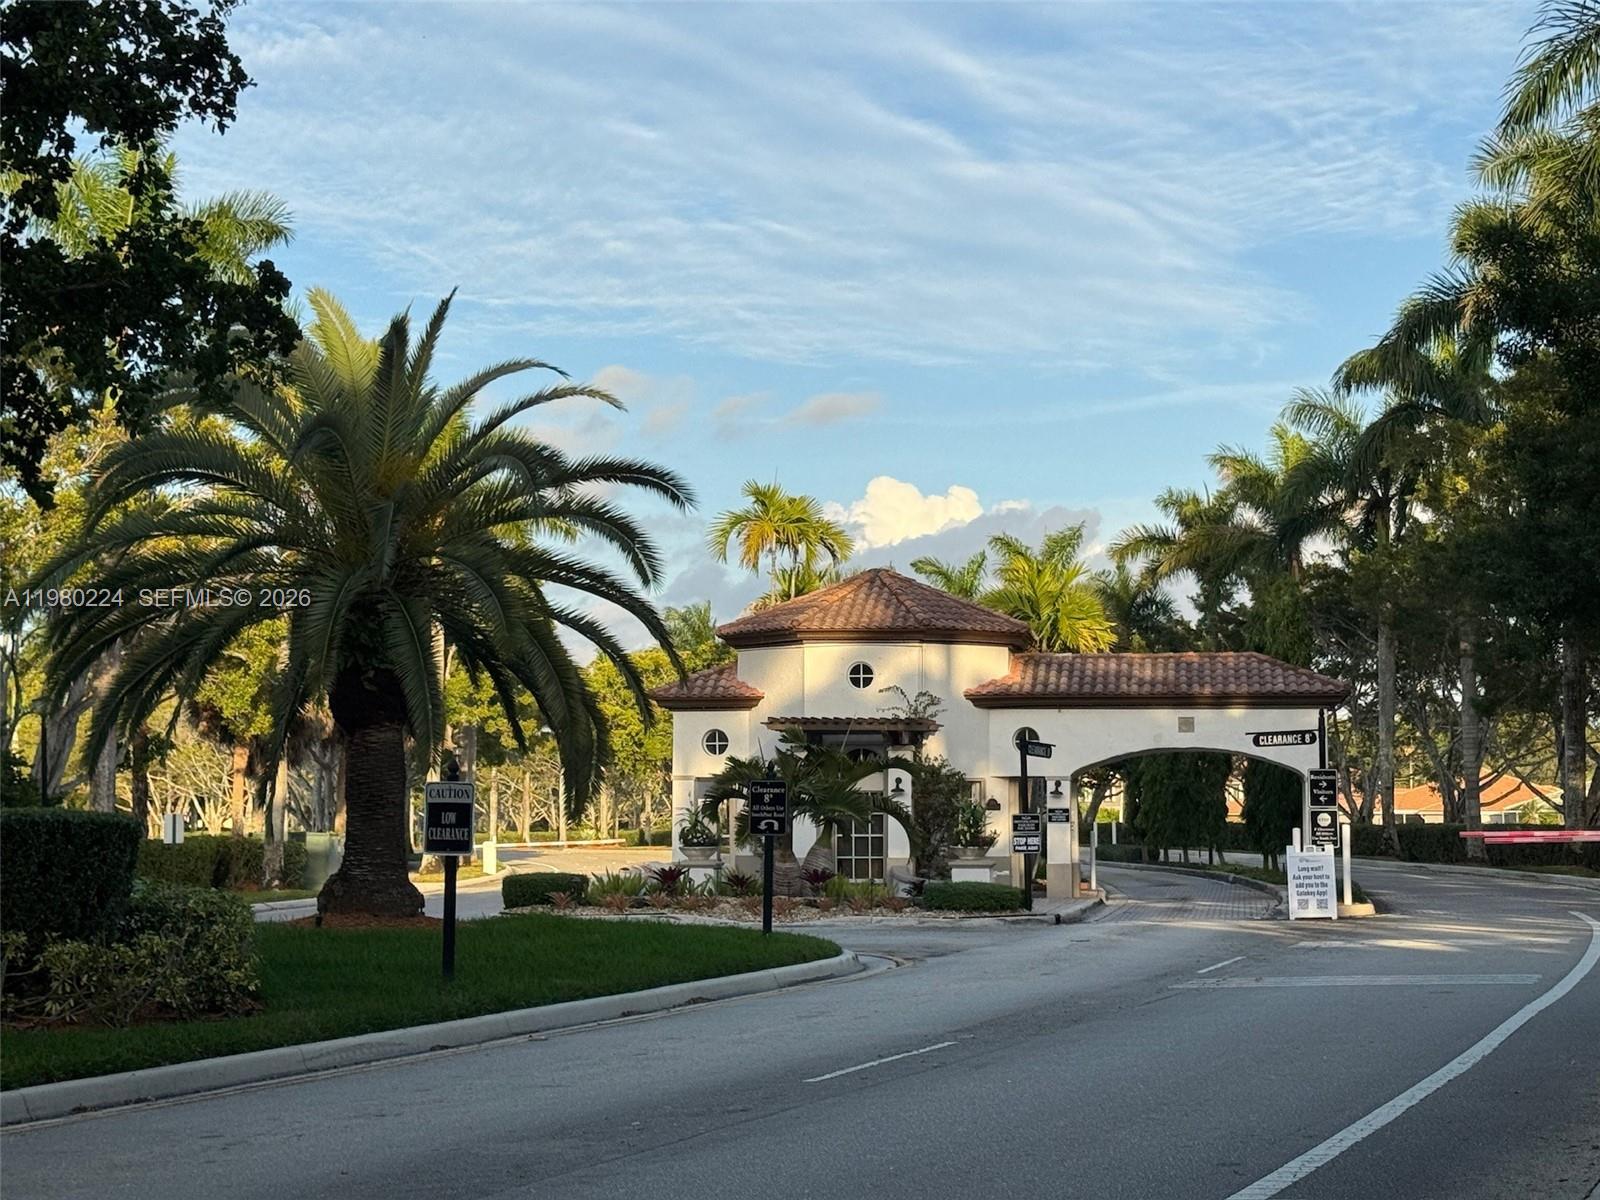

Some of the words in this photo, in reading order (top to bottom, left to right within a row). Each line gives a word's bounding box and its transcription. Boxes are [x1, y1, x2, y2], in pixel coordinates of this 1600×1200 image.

[1259, 734, 1303, 746] CLEARANCE
[429, 787, 471, 799] CAUTION
[441, 811, 457, 825] LOW
[428, 827, 470, 841] CLEARANCE
[1013, 837, 1027, 846] STOP
[1027, 836, 1040, 845] HERE
[1297, 865, 1310, 873] Long
